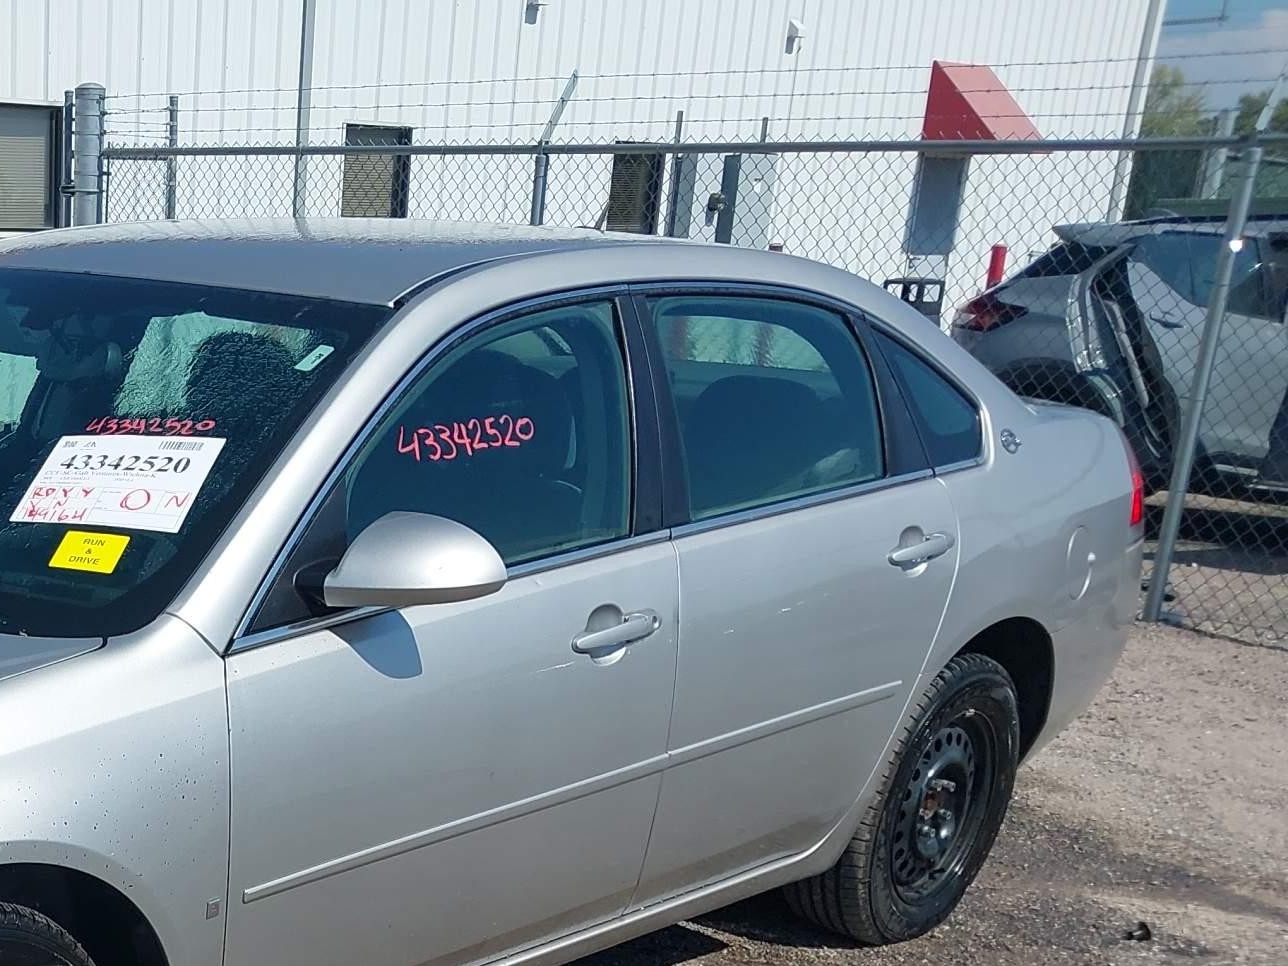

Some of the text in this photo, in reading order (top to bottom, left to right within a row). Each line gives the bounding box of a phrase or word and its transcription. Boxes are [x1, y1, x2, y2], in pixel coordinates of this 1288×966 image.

[85, 416, 216, 436] 43342520
[397, 414, 535, 462] 43342520
[60, 454, 191, 473] 43342520
[82, 538, 106, 547] RUN
[68, 555, 101, 566] DRIVE
